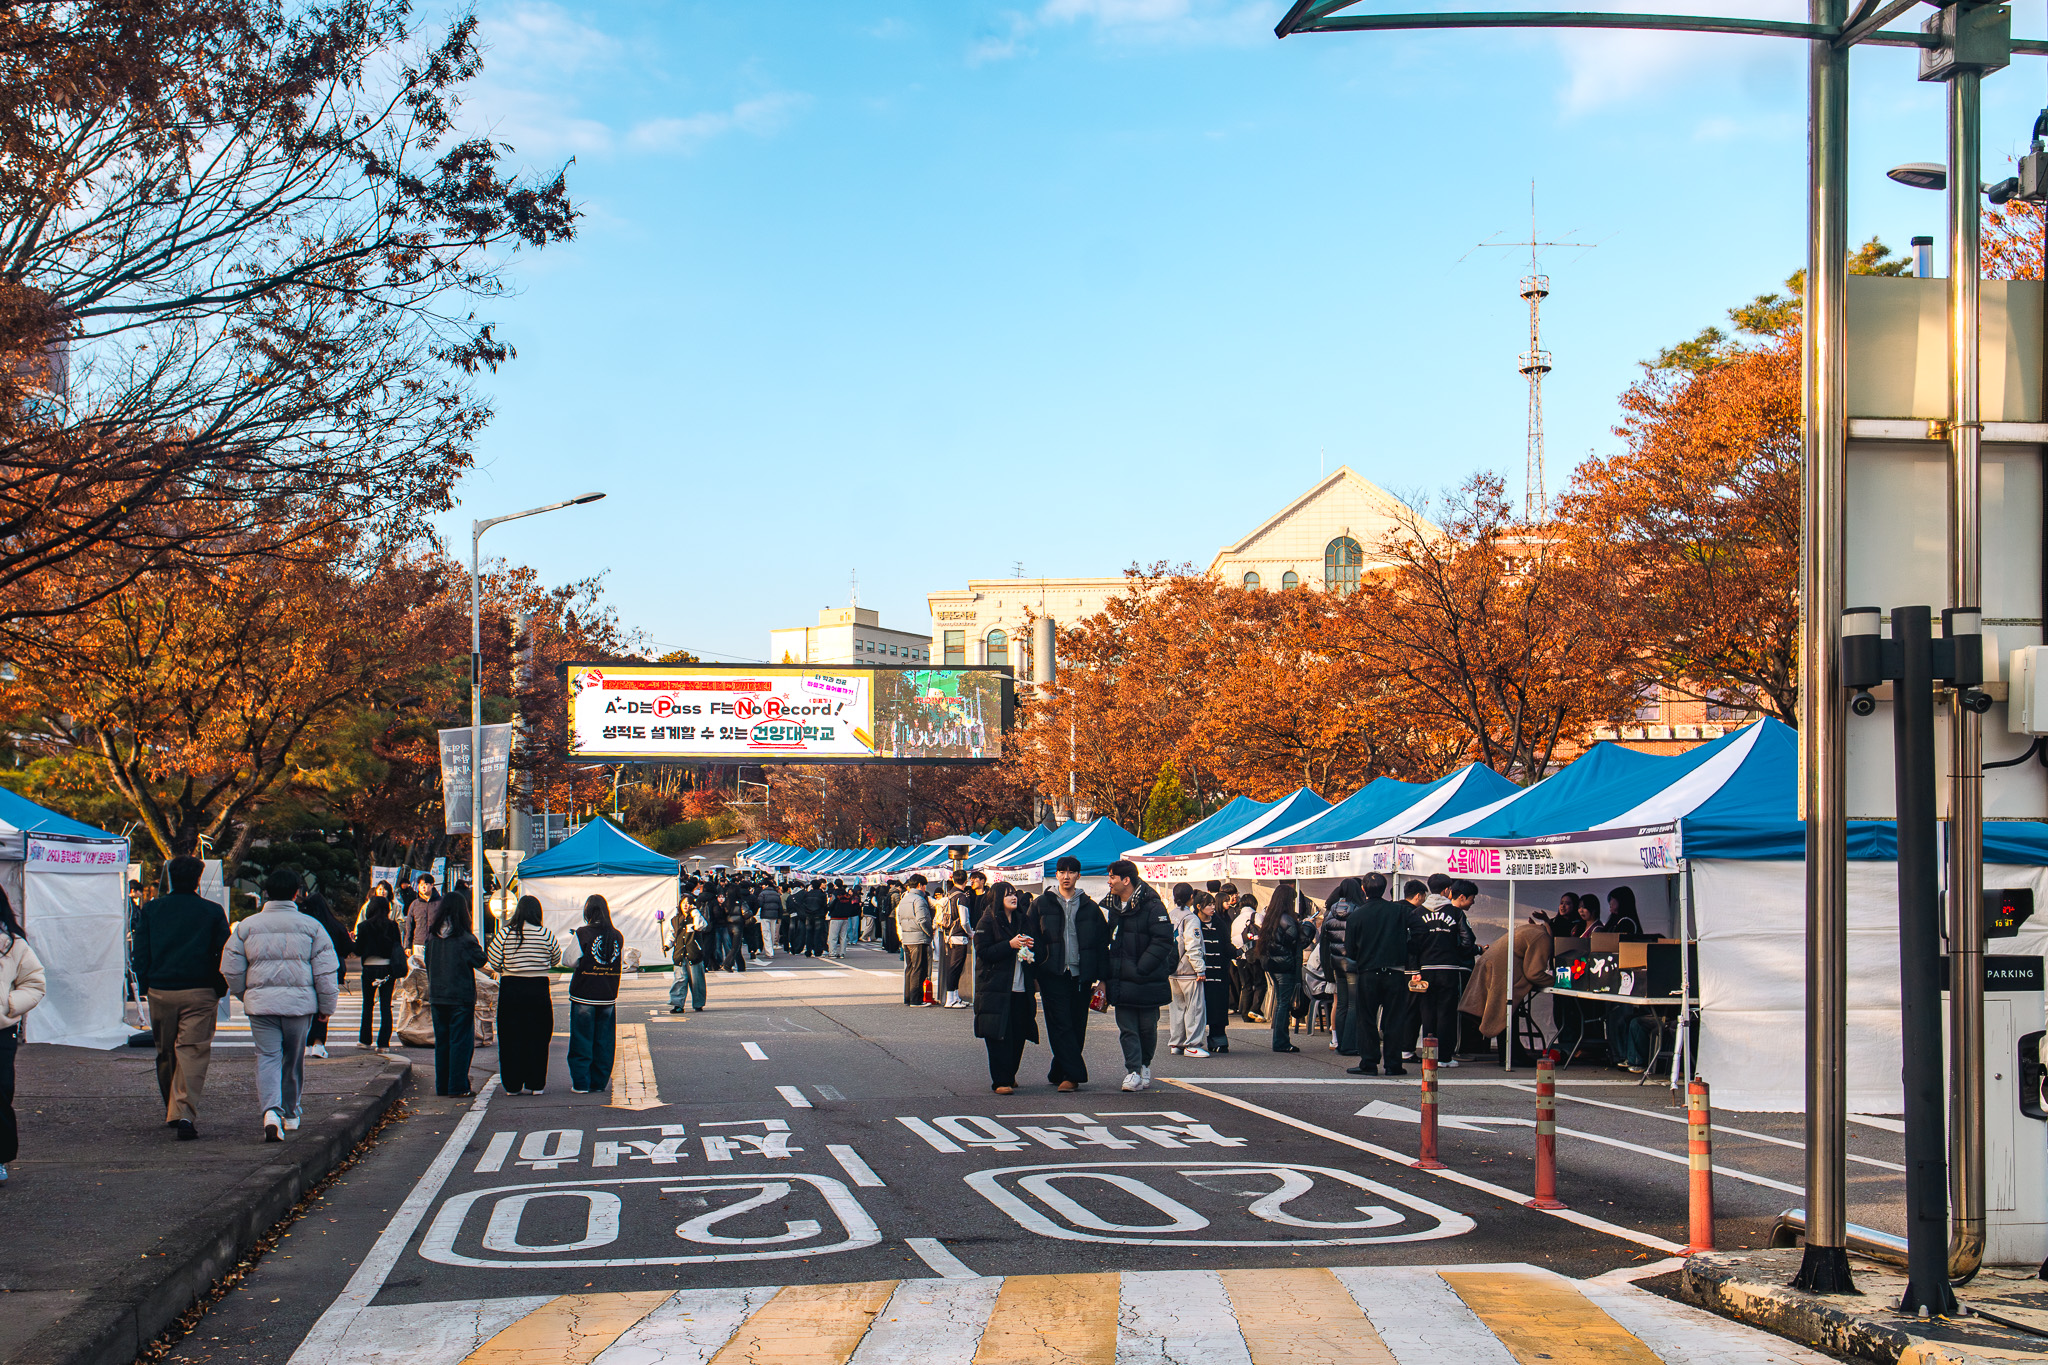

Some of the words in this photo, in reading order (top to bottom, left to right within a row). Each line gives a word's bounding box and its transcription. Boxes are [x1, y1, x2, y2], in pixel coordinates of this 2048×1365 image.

[738, 701, 762, 715] No
[602, 725, 646, 740] 성적도
[651, 725, 696, 740] 설계할
[700, 726, 714, 740] 수
[720, 726, 748, 740] 있는
[753, 726, 835, 741] 건양대학교
[1253, 855, 1292, 876] 인공지능학과
[1447, 848, 1501, 874] 소울메이트
[1506, 863, 1532, 876] 소울메이트
[1987, 969, 2034, 978] PARKING
[896, 1112, 1248, 1153] 천천히
[474, 1119, 804, 1172] 천천히
[1018, 1168, 1406, 1233] 20
[483, 1182, 822, 1253] 20
